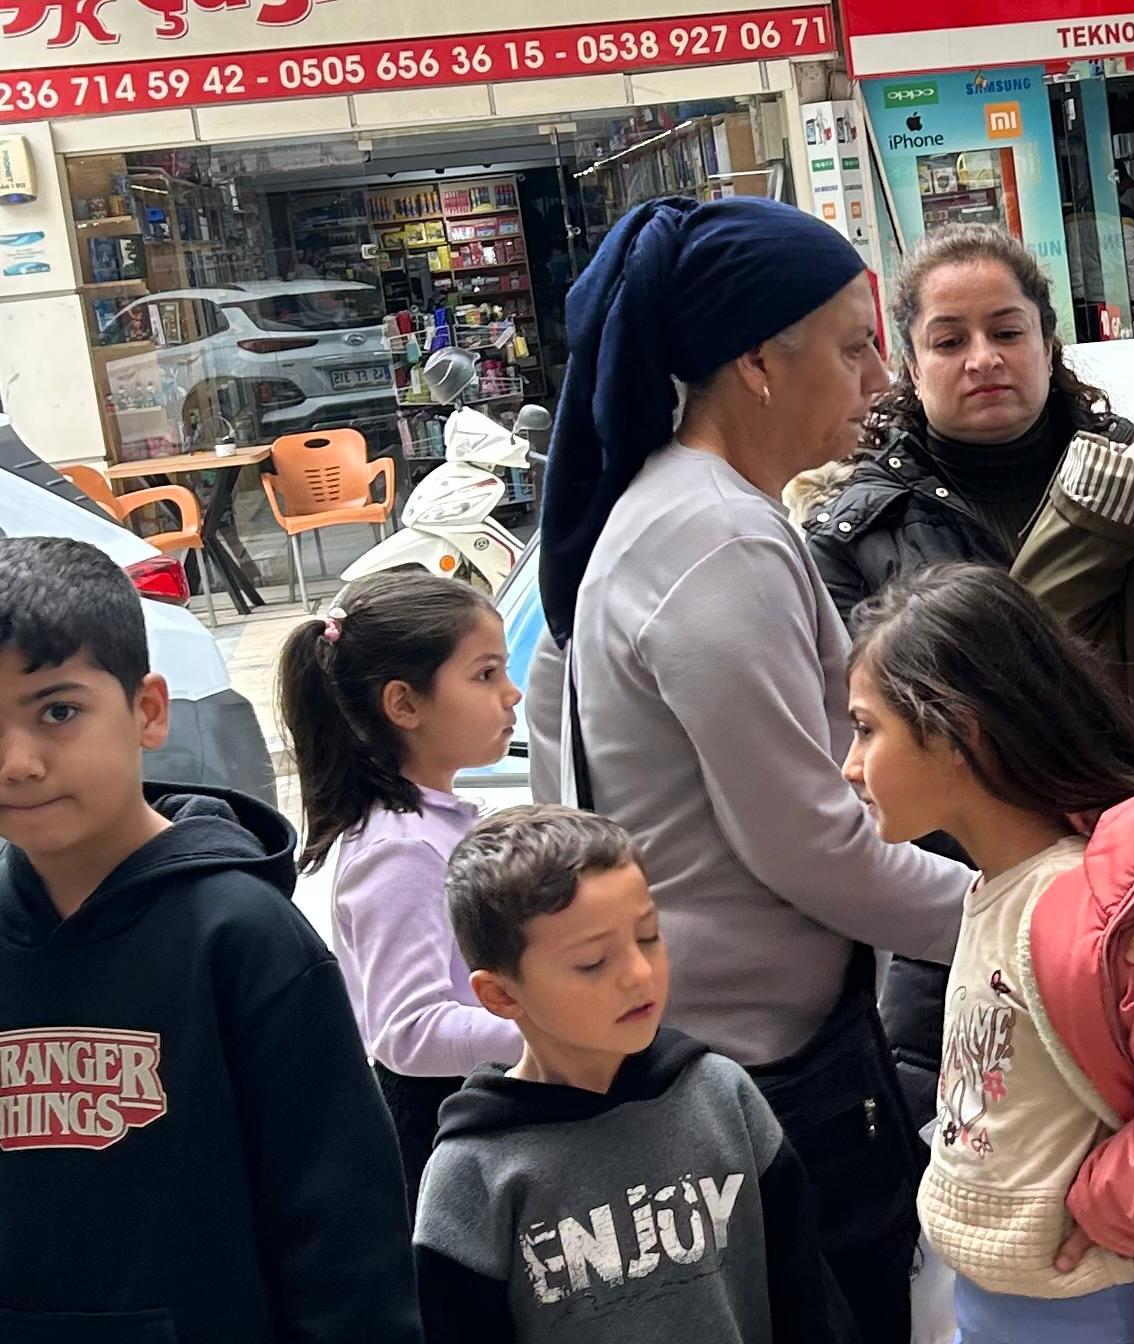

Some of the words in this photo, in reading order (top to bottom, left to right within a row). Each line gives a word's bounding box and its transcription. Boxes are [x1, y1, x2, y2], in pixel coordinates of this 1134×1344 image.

[71, 72, 136, 106] 714
[147, 68, 190, 99] 59
[202, 64, 246, 95] 42
[279, 55, 366, 89] 0505
[376, 47, 440, 81] 656
[451, 44, 493, 76] 36
[505, 41, 545, 71] 15
[576, 32, 660, 65] 0538
[669, 25, 728, 56] 927
[740, 20, 781, 51] 06
[792, 16, 826, 47] 71
[888, 132, 944, 150] iPhone
